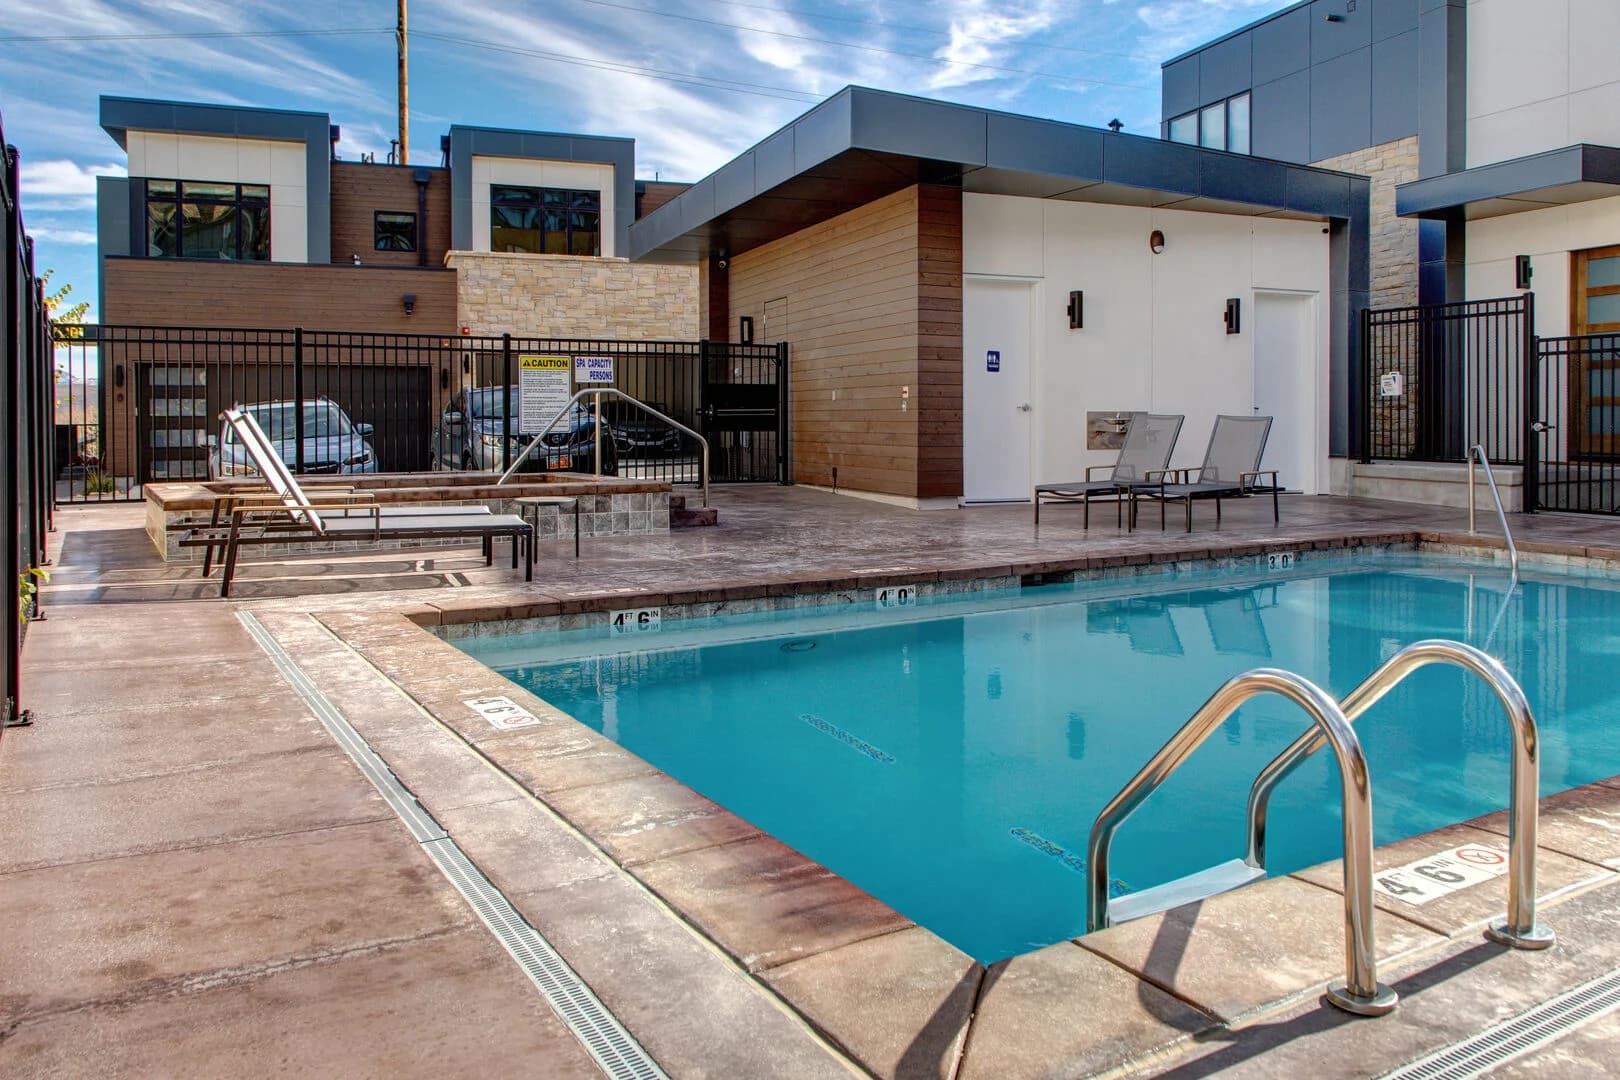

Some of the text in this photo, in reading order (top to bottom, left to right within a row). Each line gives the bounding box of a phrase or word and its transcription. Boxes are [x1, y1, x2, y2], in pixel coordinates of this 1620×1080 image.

[531, 359, 568, 368] CAUTION
[576, 358, 612, 369] SPA CAPACITY
[589, 370, 613, 380] PERSONS
[1376, 877, 1425, 896] 4
[1413, 865, 1466, 883] 6
